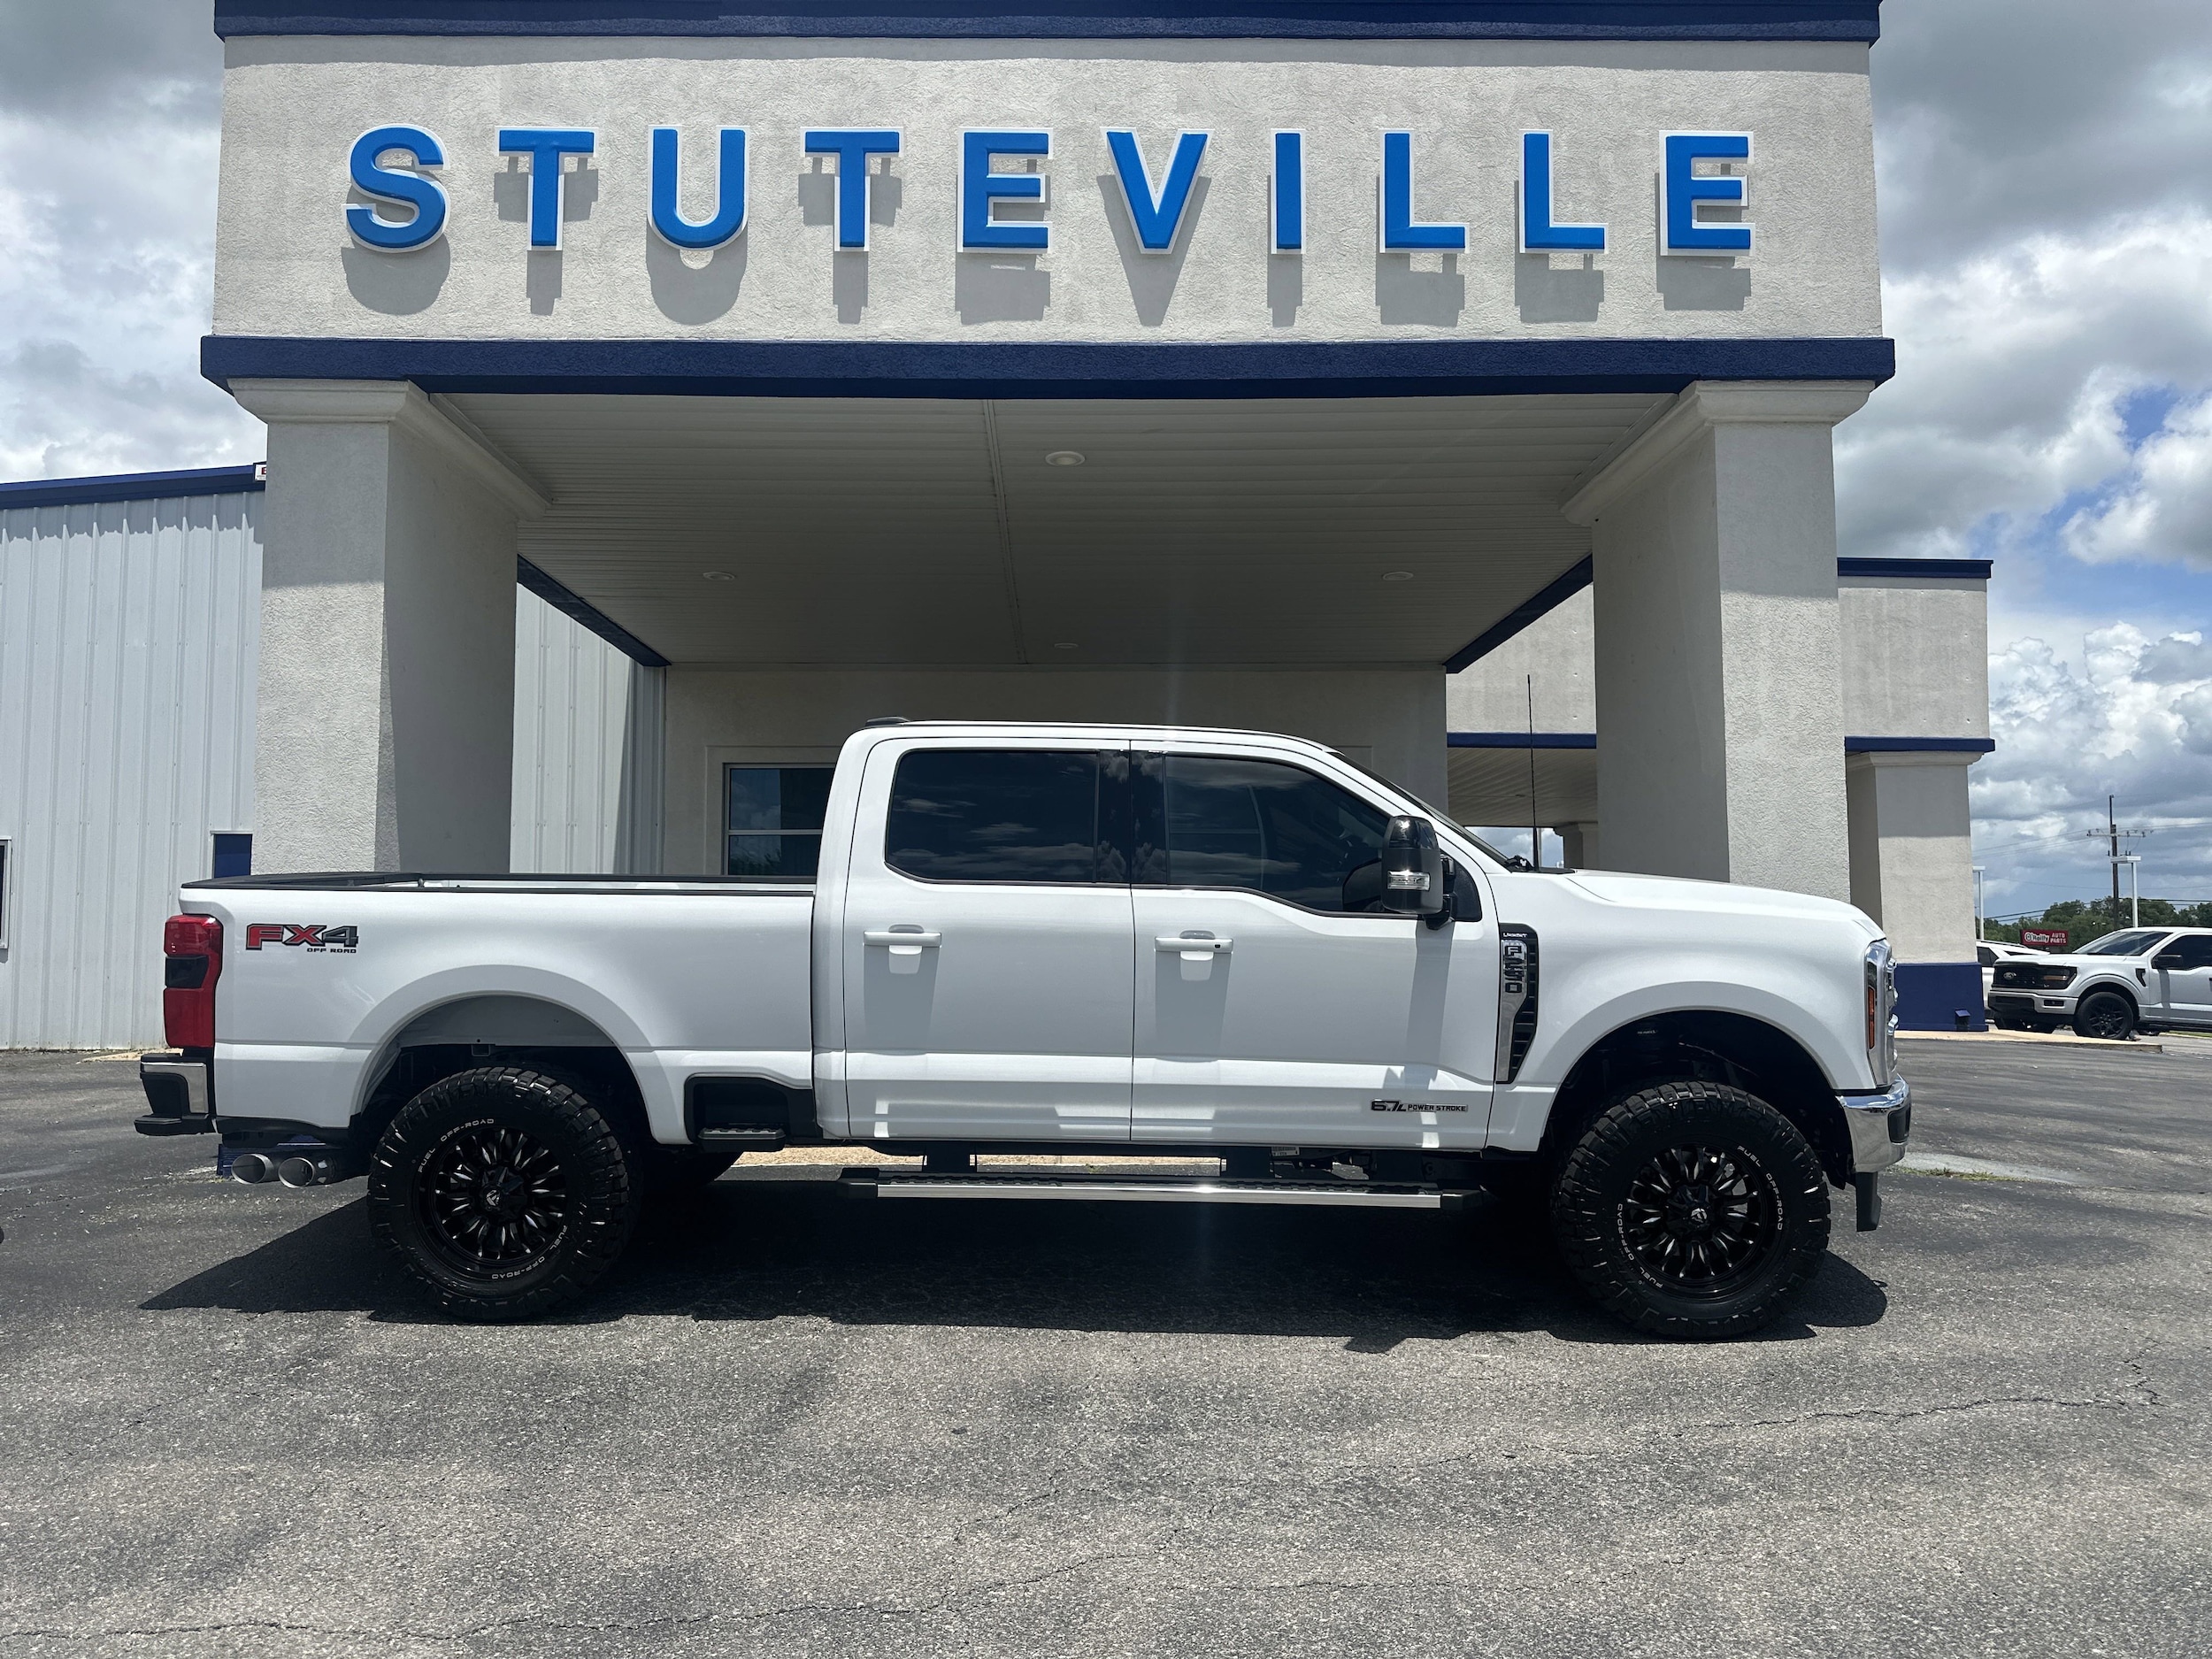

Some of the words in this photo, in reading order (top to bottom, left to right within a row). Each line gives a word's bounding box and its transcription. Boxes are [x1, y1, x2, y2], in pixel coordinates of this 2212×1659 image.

[342, 124, 1755, 257] STUTEVILLE
[246, 923, 358, 950] FX4
[1408, 1103, 1434, 1112] POWER
[418, 1148, 436, 1173] FUEL
[440, 1118, 495, 1142] OFF-ROAD
[1737, 1145, 1761, 1168] FUEL
[1765, 1172, 1784, 1231] OFF-ROAD
[549, 1225, 568, 1250] FUEL
[1617, 1203, 1635, 1261] OFF-ROAD
[491, 1256, 545, 1279] OFF-ROAD
[1640, 1266, 1663, 1288] FUEL
